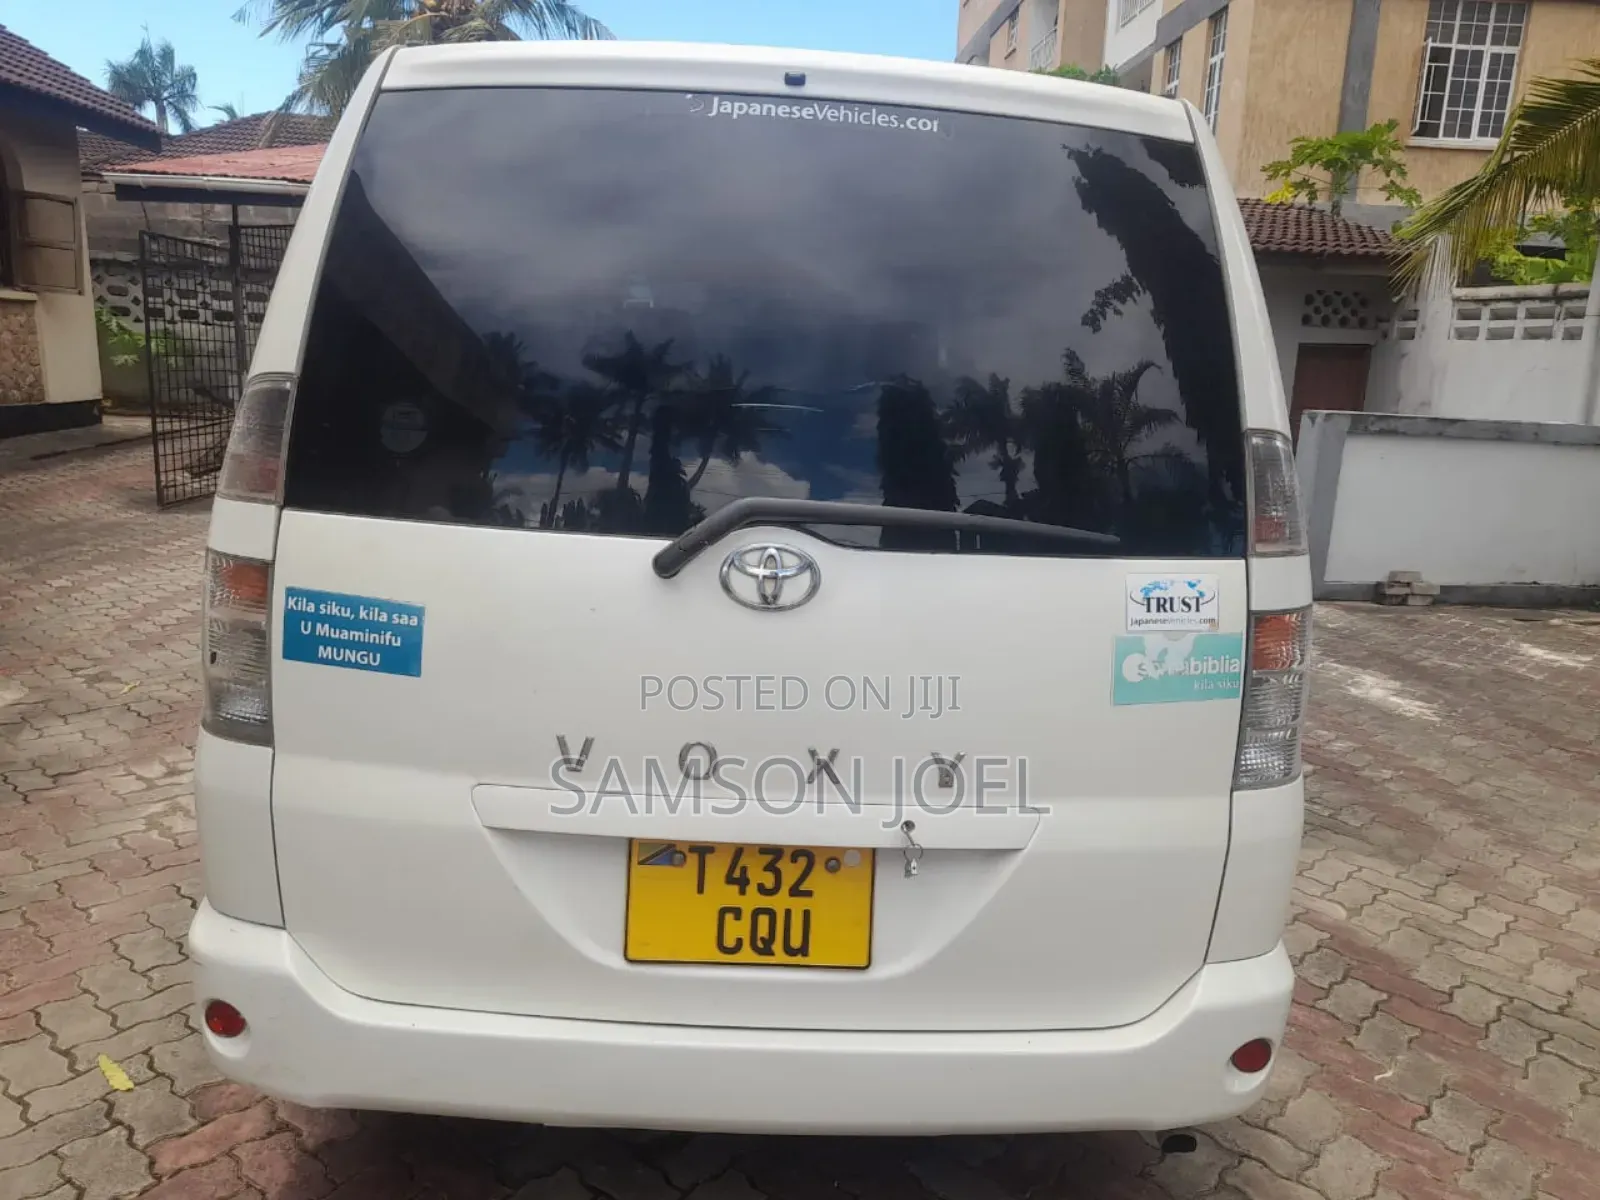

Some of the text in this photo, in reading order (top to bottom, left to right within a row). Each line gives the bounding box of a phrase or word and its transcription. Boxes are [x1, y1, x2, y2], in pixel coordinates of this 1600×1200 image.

[288, 596, 418, 626] Kila siku, kila saa
[1143, 596, 1202, 613] TRUST
[301, 620, 401, 647] U Muaminifu
[318, 645, 381, 666] MUNGU
[1193, 681, 1215, 690] kila
[555, 734, 967, 788] VOXY
[688, 845, 816, 898] T 432
[716, 906, 811, 957] CQU
